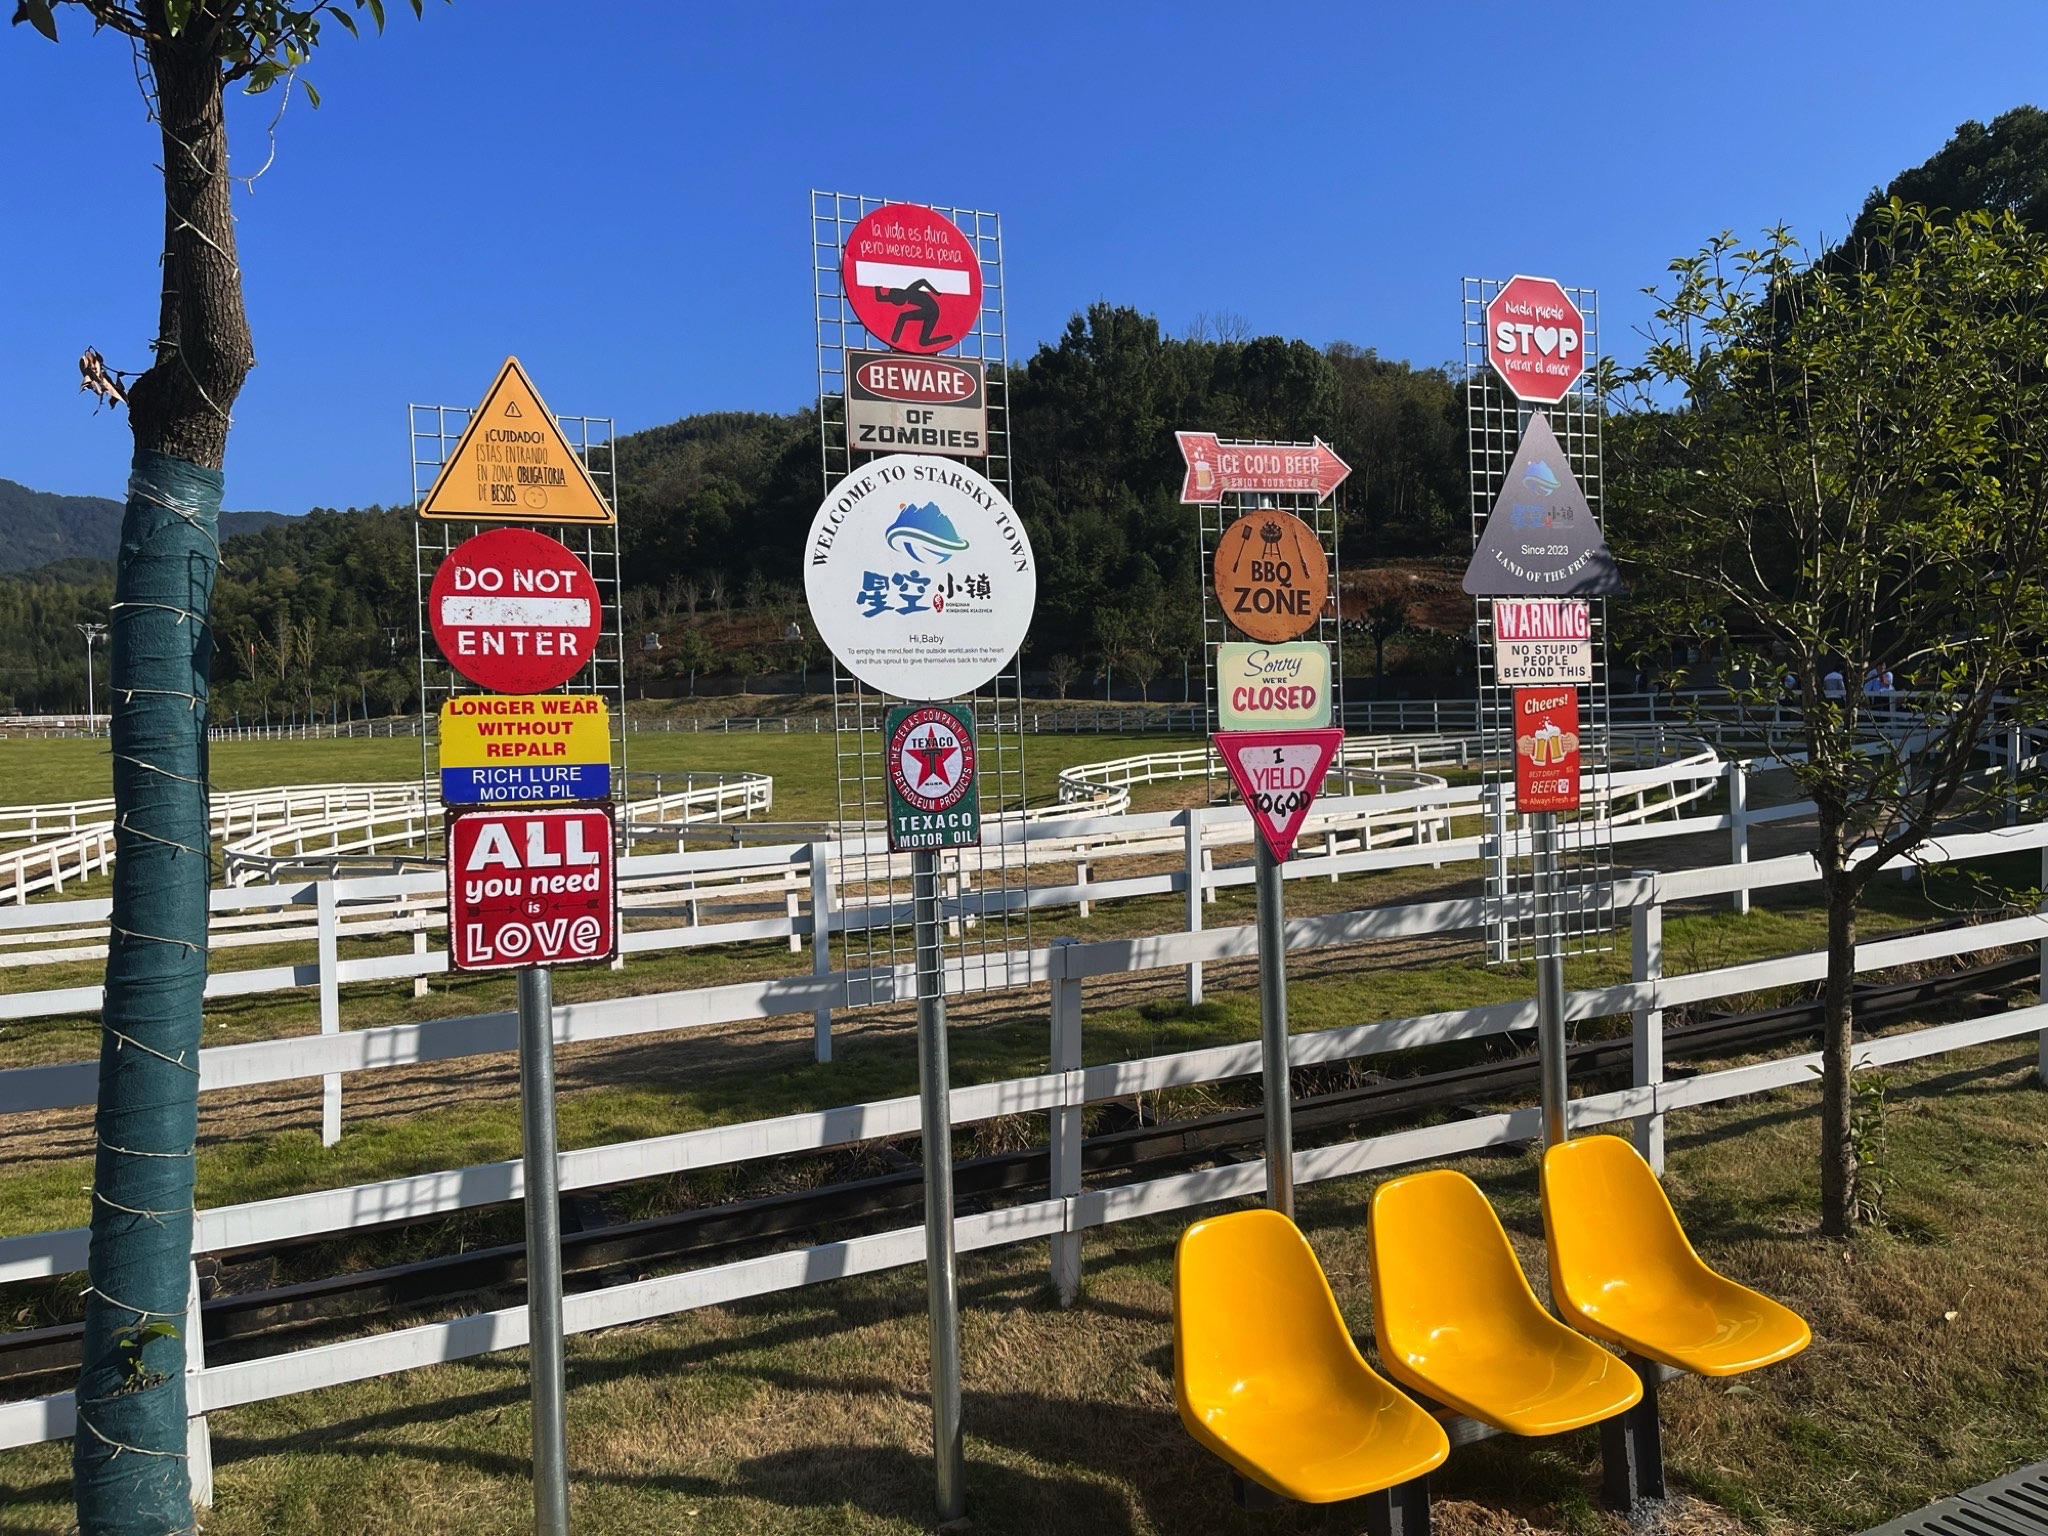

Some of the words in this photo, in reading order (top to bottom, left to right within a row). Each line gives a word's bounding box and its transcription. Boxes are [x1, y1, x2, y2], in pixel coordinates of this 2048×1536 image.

[871, 219, 882, 237] la
[884, 222, 905, 240] vida
[908, 230, 922, 242] es
[924, 226, 949, 244] dura
[860, 240, 884, 257] pero
[886, 242, 922, 258] merece
[925, 243, 936, 260] la
[938, 247, 963, 265] pena
[1505, 301, 1533, 317] Nada
[1535, 304, 1564, 322] puede
[1504, 357, 1532, 374] parar
[1535, 358, 1545, 374] el
[1546, 362, 1571, 377] amor
[869, 366, 966, 396] BEWARE
[906, 410, 935, 426] OF
[858, 424, 980, 449] ZOMBIES
[506, 446, 548, 465] ENTRANDO
[1217, 454, 1240, 474] ICE
[1244, 455, 1281, 475] COLD
[1285, 456, 1320, 475] BEER
[477, 464, 488, 482] EN
[492, 464, 514, 482] ZONA
[517, 466, 566, 485] OBLIGATORIA
[1231, 477, 1258, 488] ENJOY
[1262, 478, 1284, 488] YOUR
[1288, 478, 1310, 488] TIME
[478, 484, 488, 502] DE
[492, 484, 516, 503] BESOS
[812, 476, 878, 567] WELCOME
[877, 465, 906, 485] TO
[913, 465, 998, 512] STARSKY
[994, 512, 1030, 574] TOWN
[1521, 544, 1546, 555] Since
[1547, 545, 1569, 556] 2023
[1250, 560, 1292, 588] BBQ
[1495, 550, 1524, 578] LAND
[1526, 570, 1542, 582] OF
[1543, 568, 1567, 582] THE
[1568, 549, 1593, 576] FREE
[454, 566, 504, 592] DO
[512, 568, 578, 593] NOT
[1233, 587, 1312, 616] ZONE
[1499, 603, 1587, 638] WARNING
[458, 631, 578, 656] ENTER
[856, 648, 875, 656] empty
[1511, 645, 1531, 656] NO
[1534, 644, 1578, 655] STUPID
[884, 658, 902, 666] sprout
[910, 658, 922, 666] give
[957, 656, 972, 664] back
[972, 656, 978, 664] to
[979, 656, 997, 664] nature
[1244, 650, 1303, 678] Sorry
[1524, 656, 1568, 666] PEOPLE
[1504, 667, 1554, 678] BEYOND
[1559, 666, 1586, 676] THIS
[450, 701, 535, 716] LONGER
[541, 700, 599, 715] WEAR
[1232, 686, 1317, 712] CLOSED
[1524, 694, 1568, 715] Cheers!
[477, 722, 574, 736] WITHOUT
[894, 714, 919, 742] TEXAS
[923, 710, 964, 735] COMPANY
[486, 742, 566, 758] REPALR
[911, 736, 954, 748] TEXACO
[892, 745, 901, 766] THE
[1272, 748, 1284, 764] I
[472, 768, 522, 784] RICH
[530, 767, 583, 782] LURE
[1252, 766, 1306, 791] YIELD
[1528, 770, 1542, 778] BEST
[1542, 770, 1560, 778] DRAFT
[480, 786, 544, 800] MOTOR
[550, 785, 576, 798] PIL
[892, 771, 936, 810] PETROLEUM
[940, 767, 973, 809] PRODUCTS
[1530, 780, 1558, 794] BEER
[1530, 797, 1551, 806] Always
[1552, 796, 1568, 804] Fresh
[899, 812, 972, 832] TEXACO
[466, 820, 600, 872] ALL
[900, 833, 943, 848] MOTOR
[953, 831, 973, 844] OIL
[465, 878, 522, 904] you
[530, 868, 600, 894] need
[528, 900, 540, 914] is
